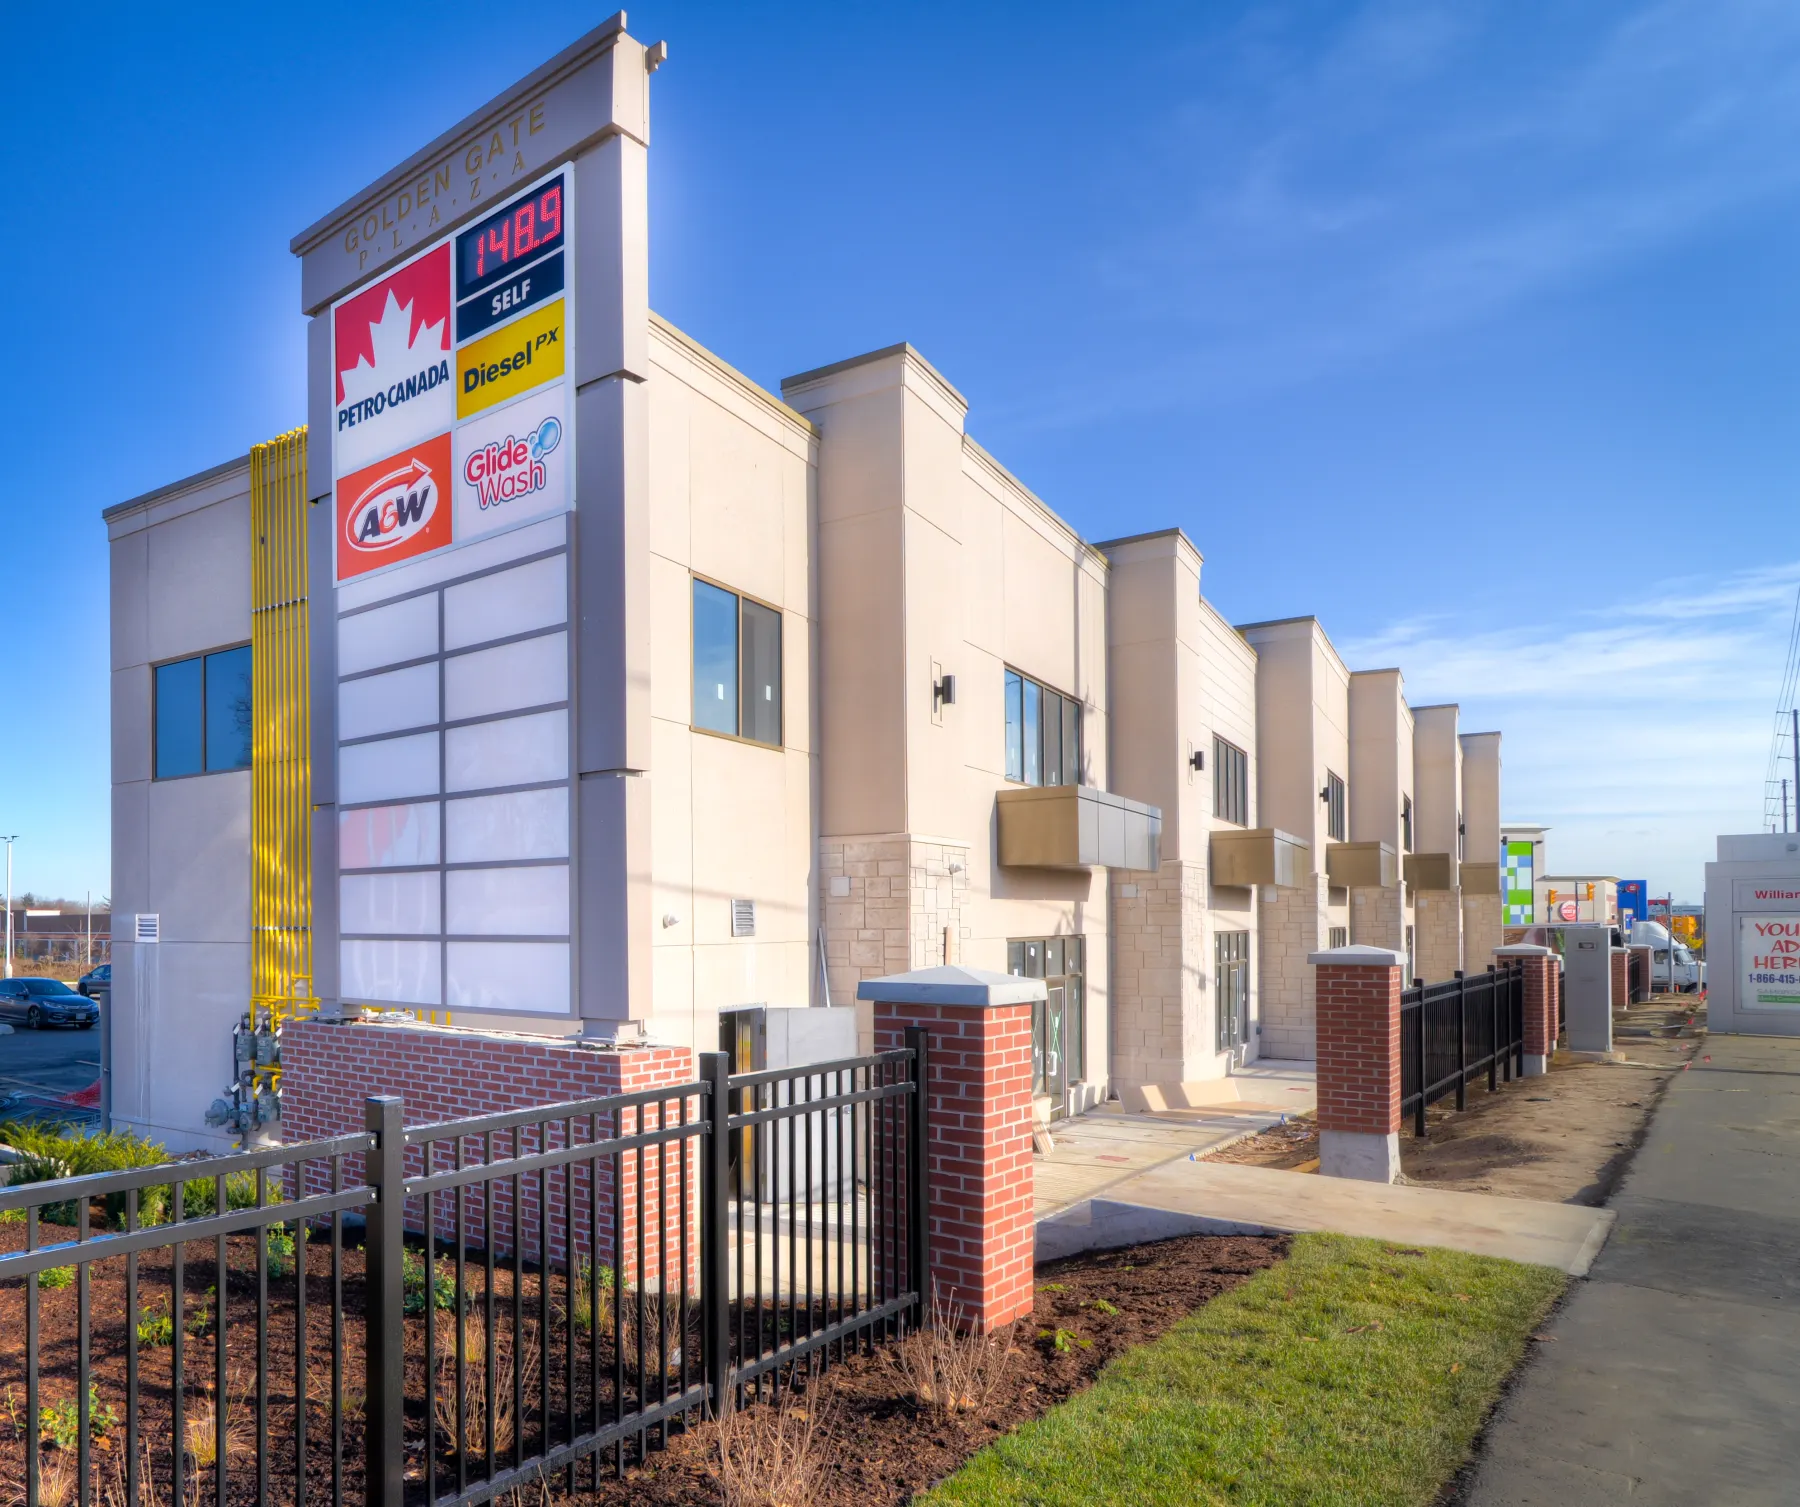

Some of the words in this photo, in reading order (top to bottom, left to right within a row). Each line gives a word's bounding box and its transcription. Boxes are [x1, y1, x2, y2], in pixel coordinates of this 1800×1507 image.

[345, 165, 451, 253] GOLDEN
[465, 103, 545, 175] GATE
[477, 186, 561, 277] 148.9
[492, 278, 531, 316] SELF
[464, 340, 532, 394] Diesel
[535, 326, 560, 351] PX
[467, 440, 529, 483] Glide
[480, 460, 544, 507] Wash
[357, 484, 431, 544] A&W
[1748, 973, 1800, 985] 1-866-415-
[1754, 955, 1800, 970] HER
